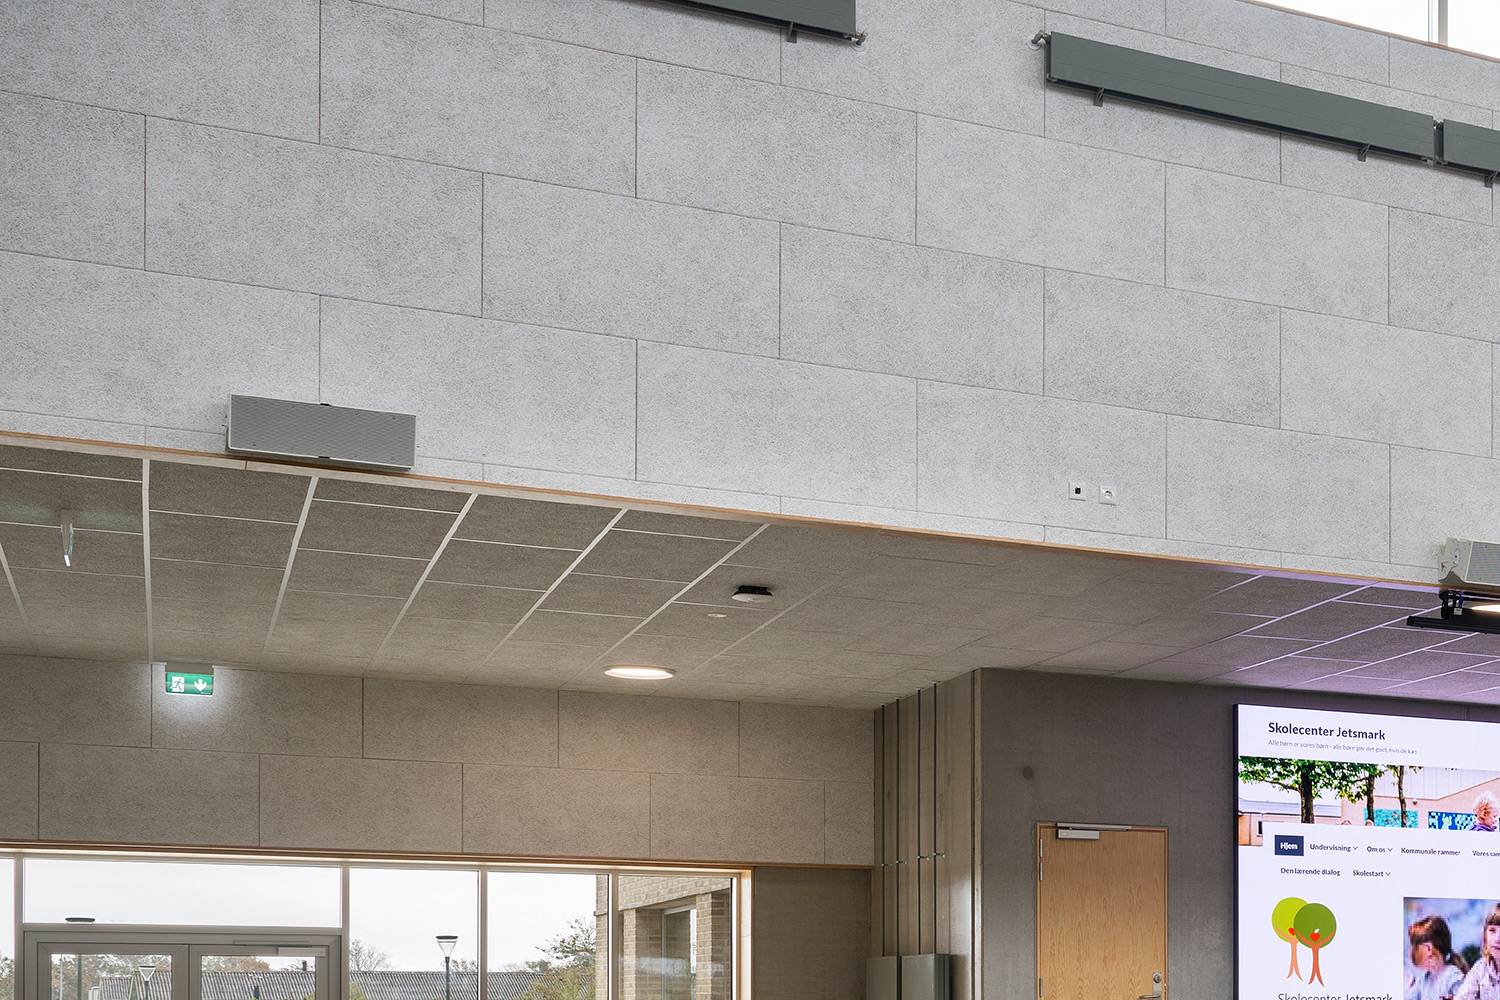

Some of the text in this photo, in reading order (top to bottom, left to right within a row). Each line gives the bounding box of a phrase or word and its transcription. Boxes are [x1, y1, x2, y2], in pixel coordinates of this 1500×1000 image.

[1268, 722, 1386, 740] Skolecenter Jetsmark
[1280, 841, 1298, 852] Hjem
[1310, 843, 1352, 853] Undervisning
[1367, 845, 1378, 853] Om
[1401, 847, 1437, 856] Kommunale
[1280, 867, 1340, 877] Den lærende dialog
[1353, 869, 1384, 877] Skolestart
